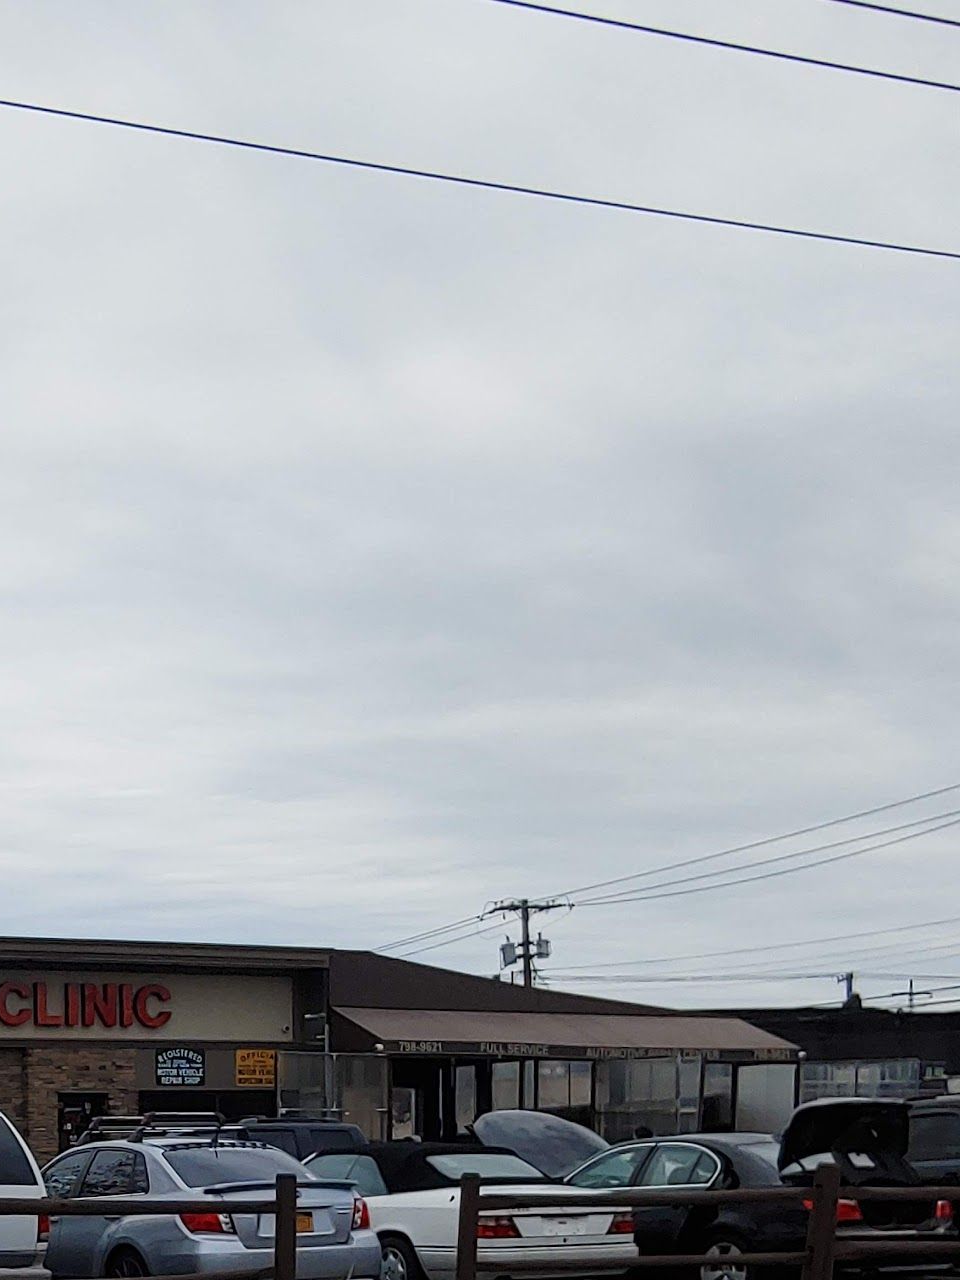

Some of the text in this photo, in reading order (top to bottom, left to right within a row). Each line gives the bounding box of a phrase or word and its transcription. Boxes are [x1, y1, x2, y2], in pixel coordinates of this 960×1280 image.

[157, 1048, 203, 1063] REGISTERED
[480, 1042, 549, 1056] FULL SERVICE
